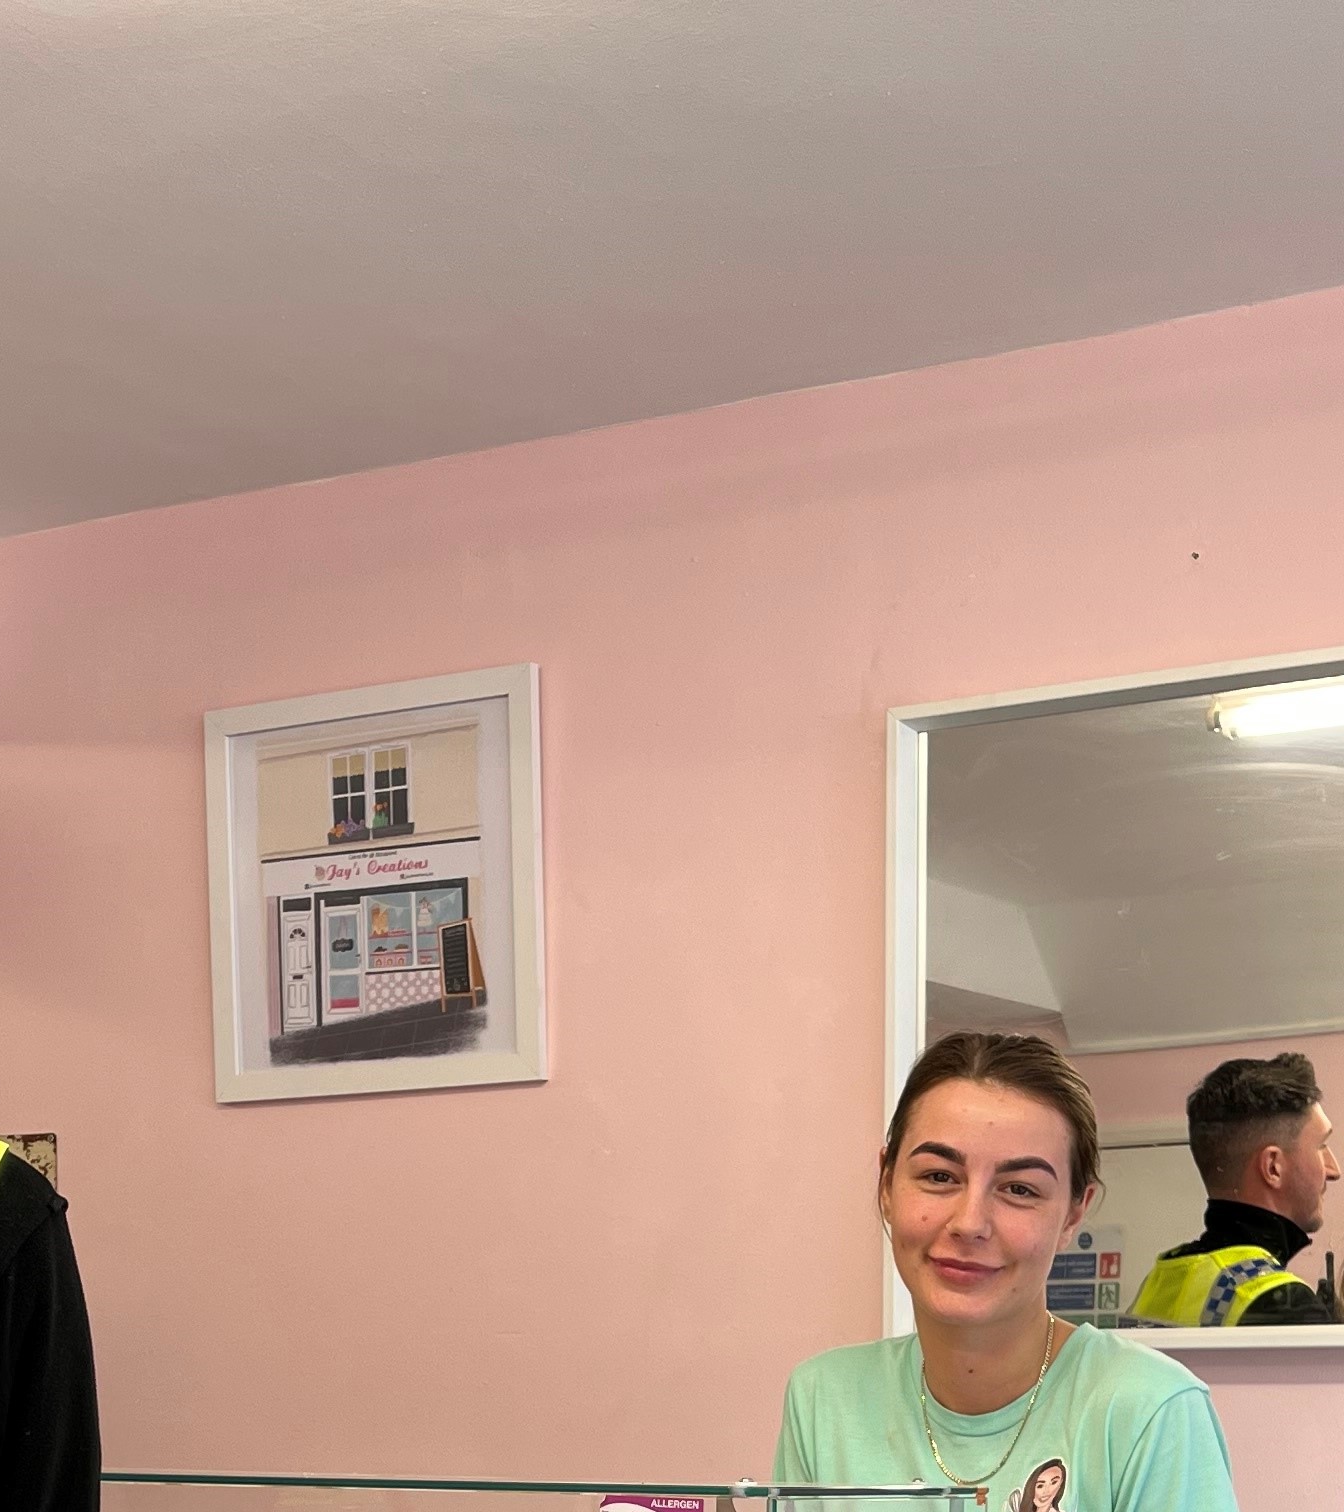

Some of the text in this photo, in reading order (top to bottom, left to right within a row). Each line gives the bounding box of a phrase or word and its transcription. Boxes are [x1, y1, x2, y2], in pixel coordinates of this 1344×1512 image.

[327, 858, 429, 880] Jay's Creations
[651, 1499, 699, 1509] ALLERGEN
